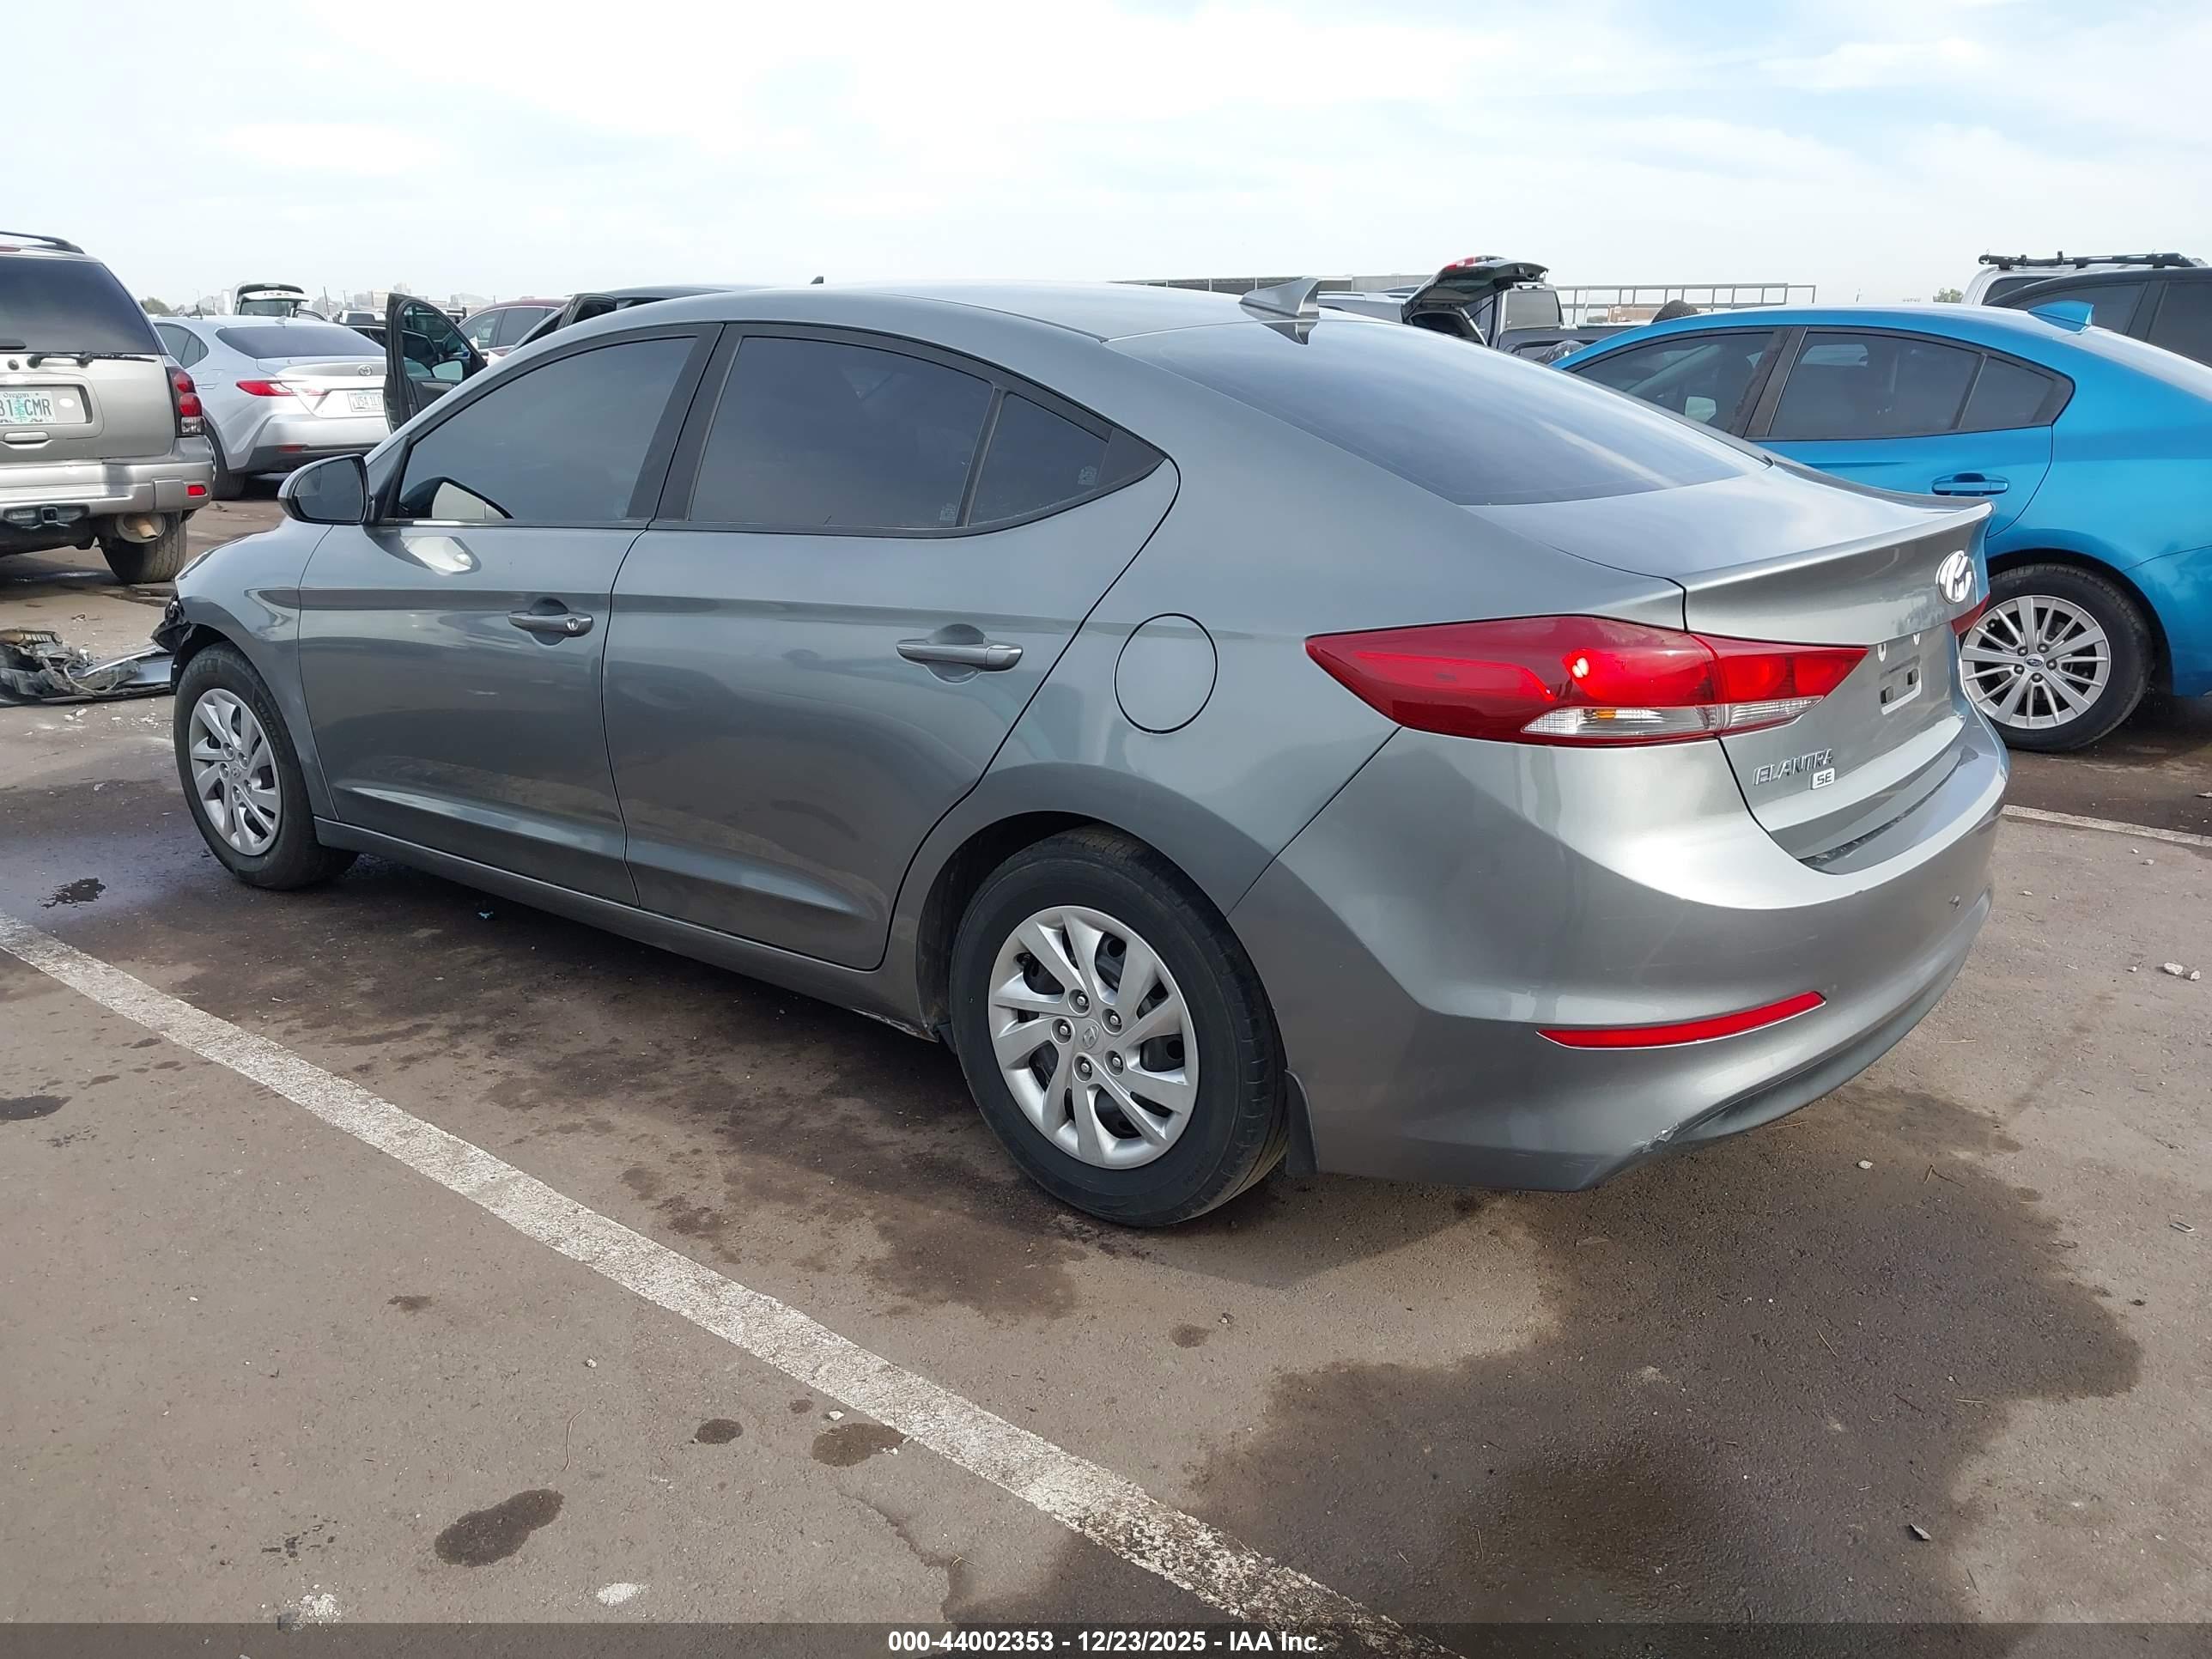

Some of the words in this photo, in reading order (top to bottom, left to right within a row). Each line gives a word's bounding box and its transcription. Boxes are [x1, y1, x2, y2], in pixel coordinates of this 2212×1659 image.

[24, 398, 52, 416] CMR
[1753, 748, 1833, 786] ELANTRA
[1816, 771, 1832, 786] SE
